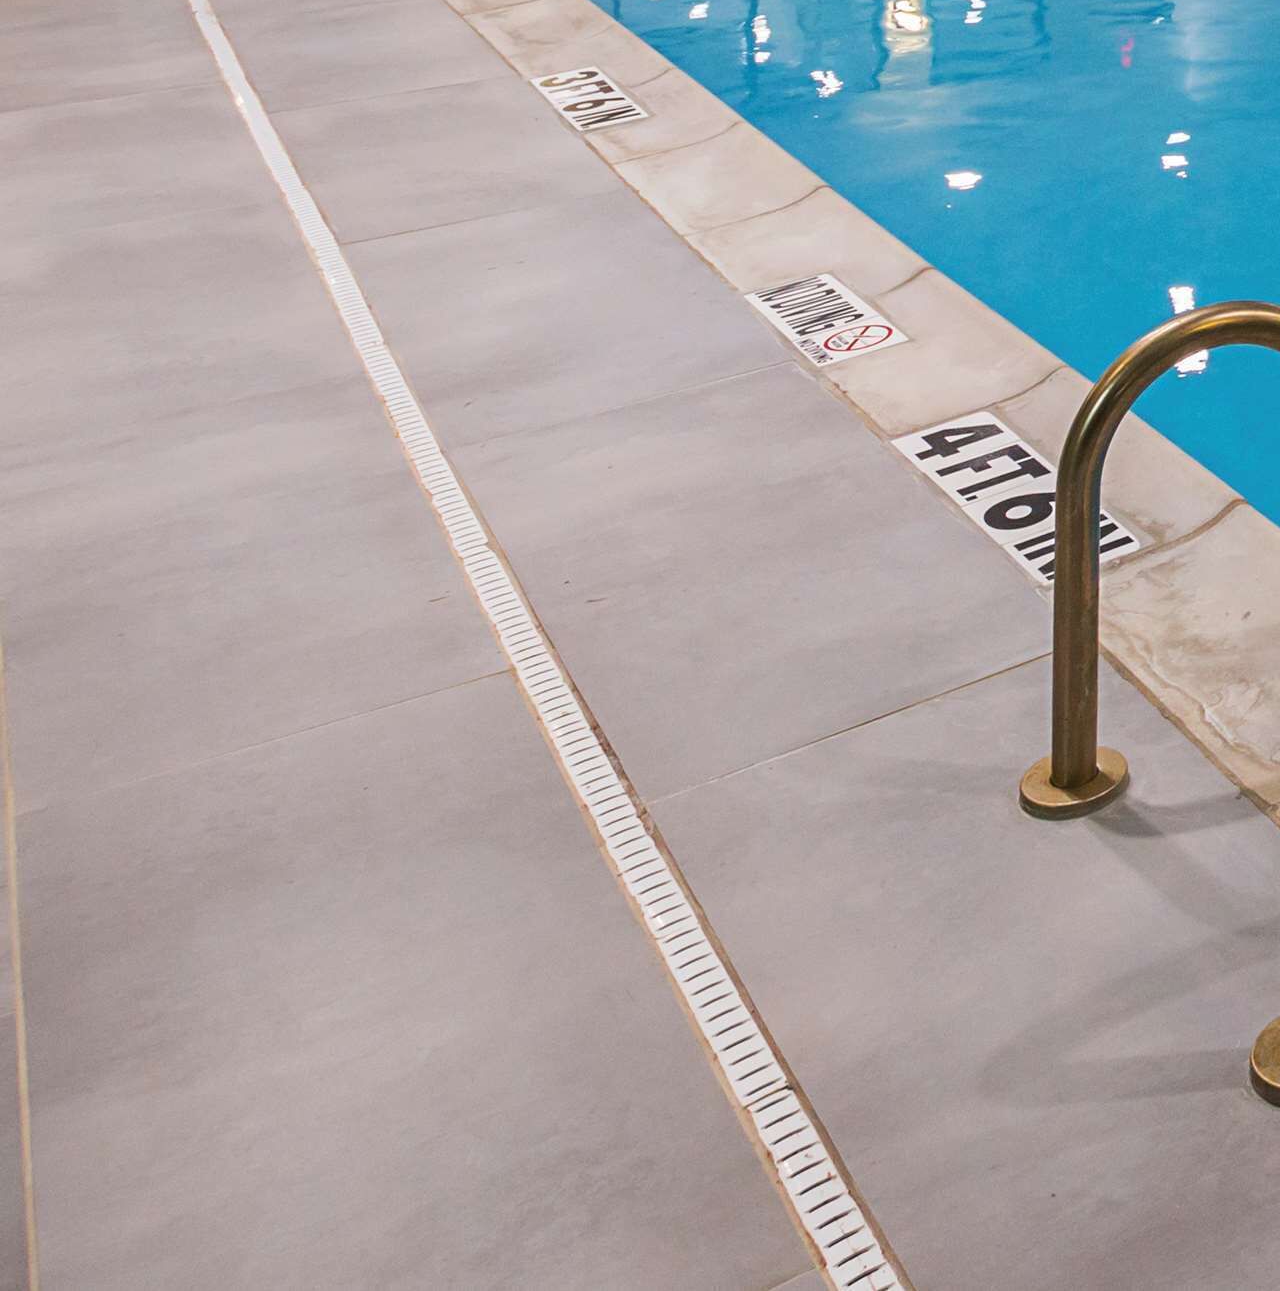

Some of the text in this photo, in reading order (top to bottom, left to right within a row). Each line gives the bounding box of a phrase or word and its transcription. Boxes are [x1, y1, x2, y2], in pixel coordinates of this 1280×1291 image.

[754, 276, 865, 337] NO DIVING
[914, 422, 1004, 462] 4
[983, 491, 1056, 531] 6
